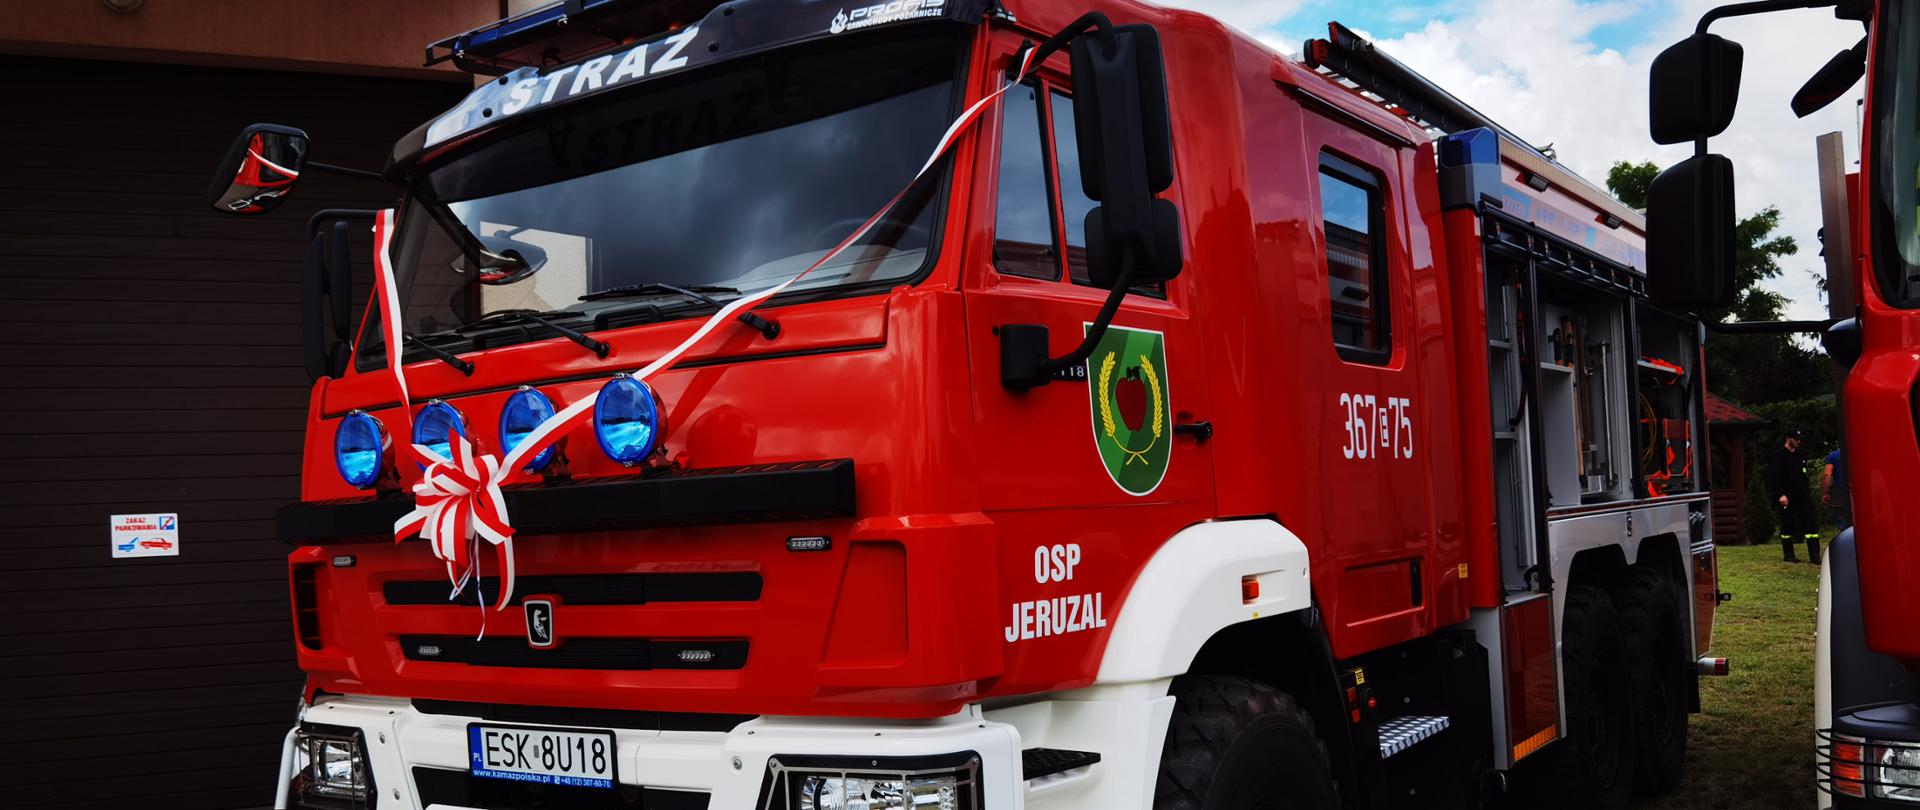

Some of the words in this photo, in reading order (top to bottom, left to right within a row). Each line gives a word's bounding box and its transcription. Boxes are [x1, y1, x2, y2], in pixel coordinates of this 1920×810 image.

[114, 524, 157, 532] PARKOWANIA
[1034, 543, 1081, 584] OSP
[1004, 592, 1107, 643] JERUZAL
[472, 752, 482, 762] PL
[485, 731, 532, 770] ESK
[541, 734, 606, 775] 8U18
[472, 769, 551, 784] www.kamazpolska.pl
